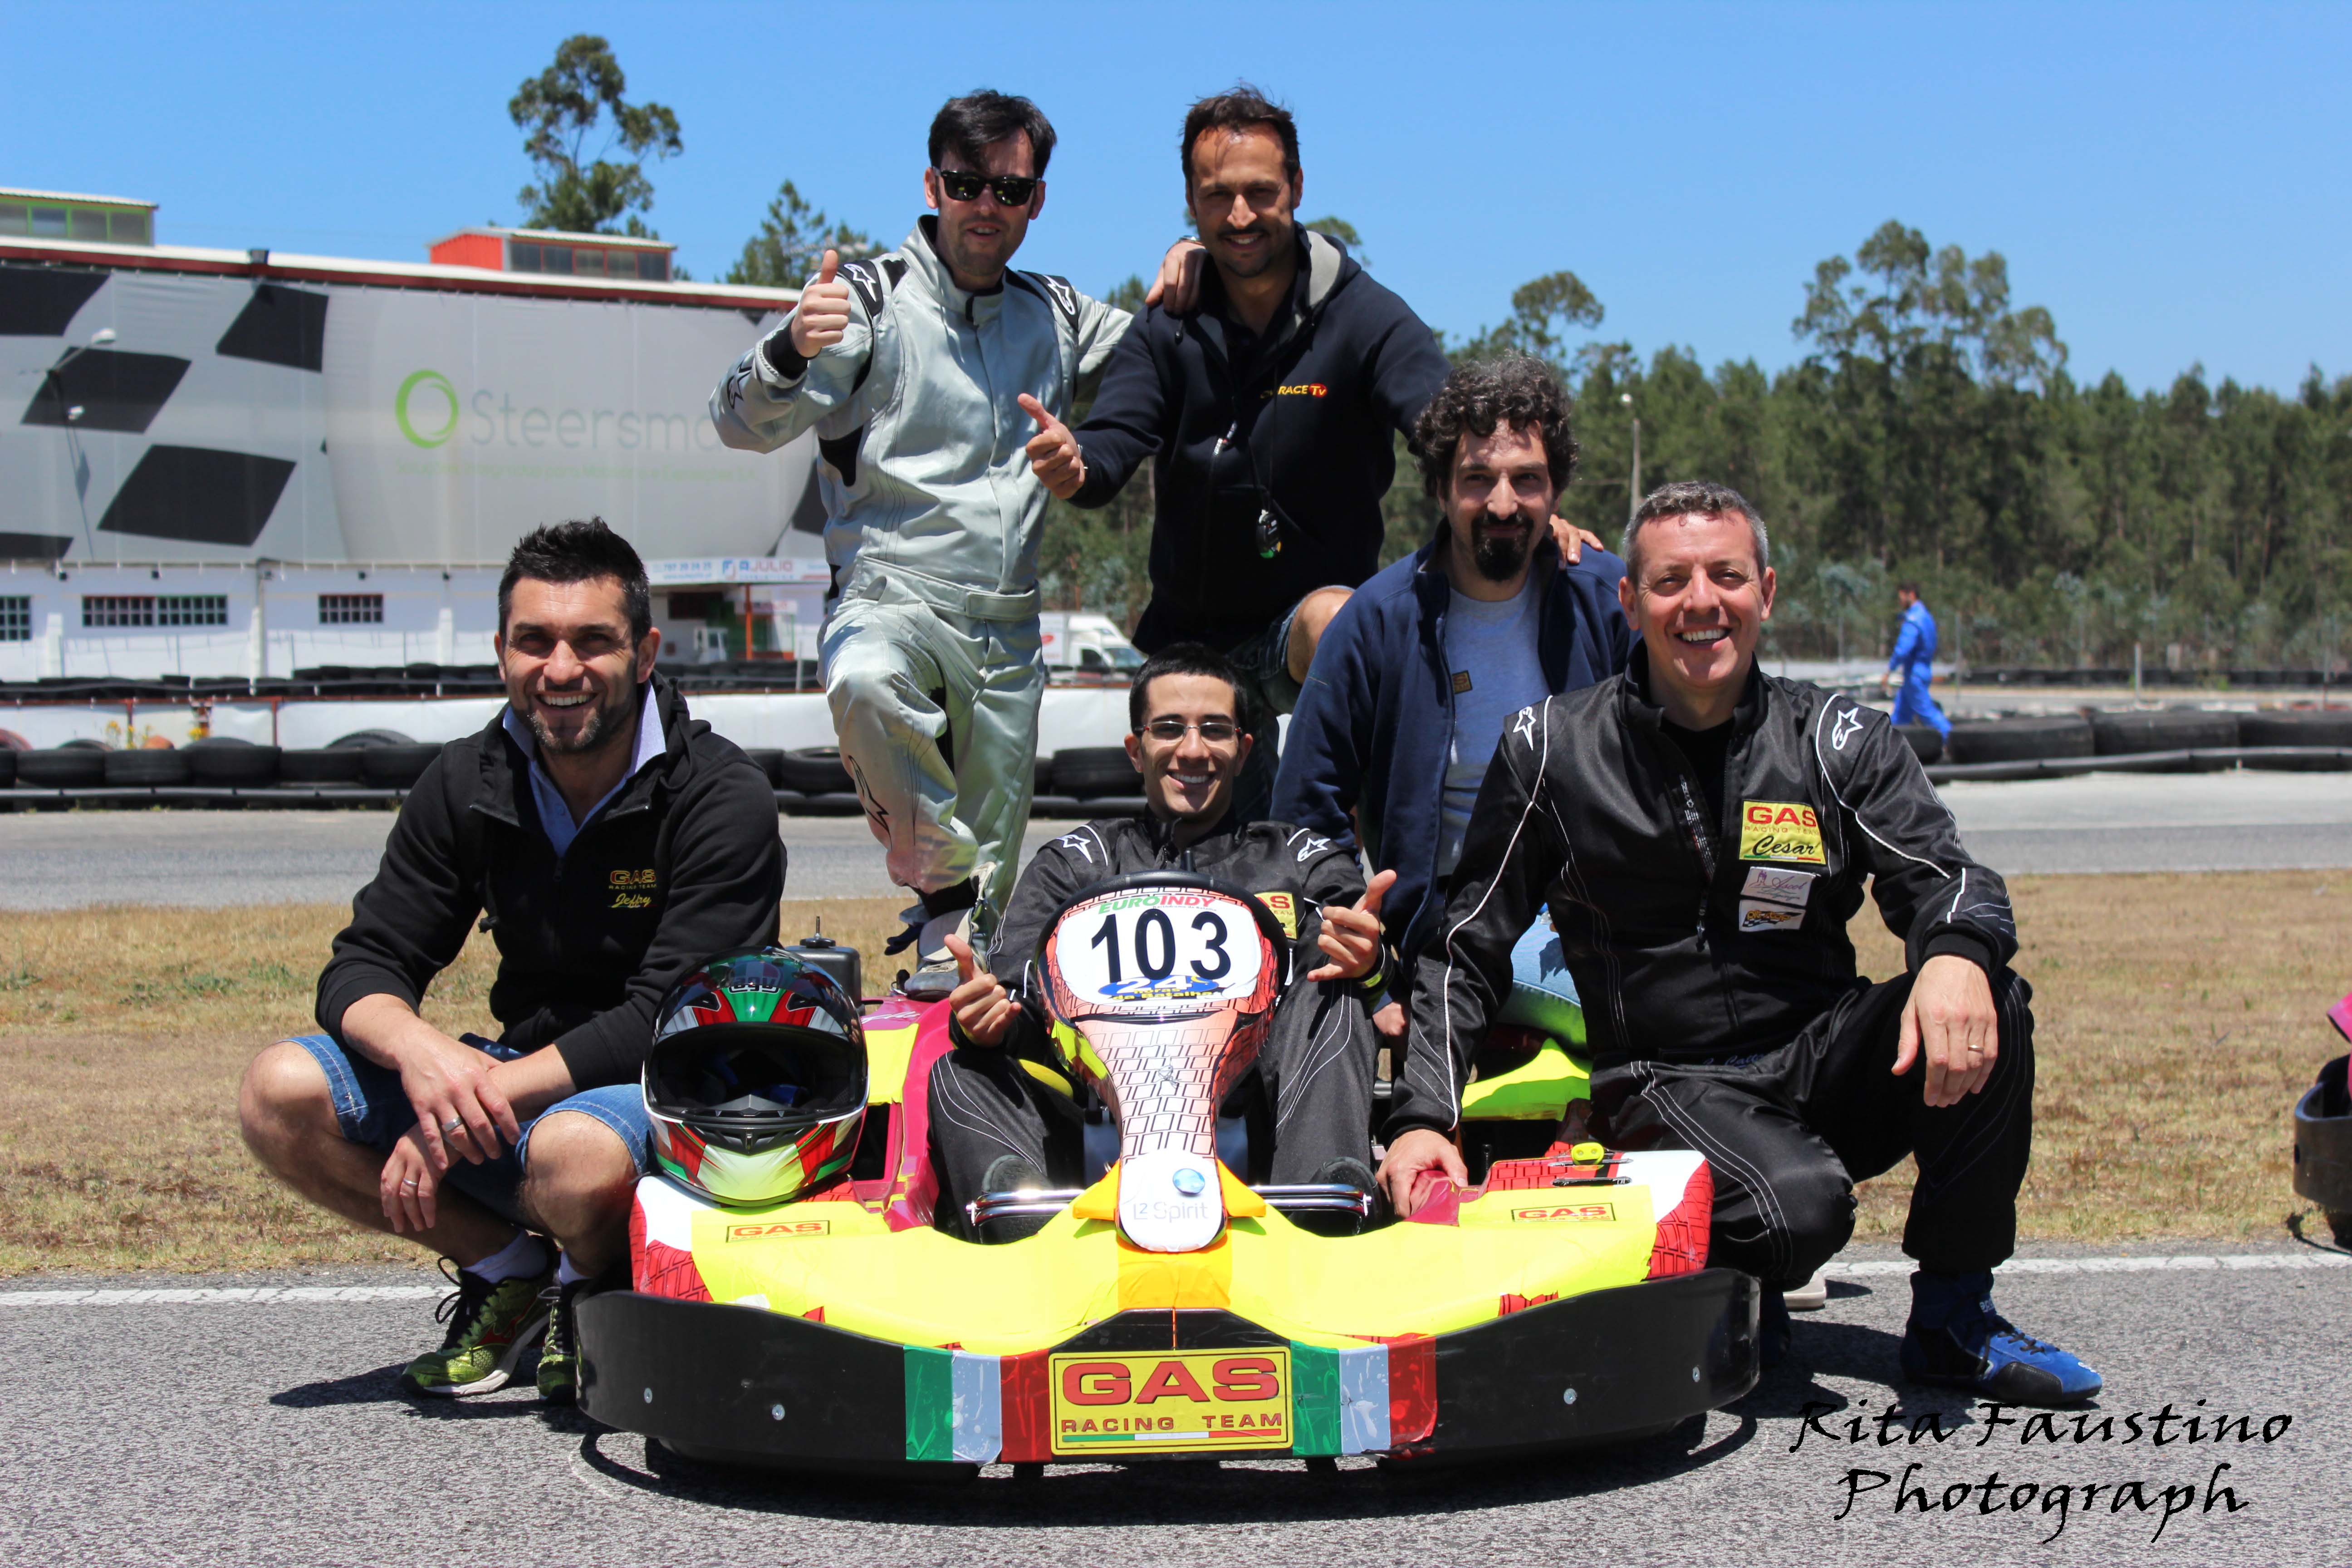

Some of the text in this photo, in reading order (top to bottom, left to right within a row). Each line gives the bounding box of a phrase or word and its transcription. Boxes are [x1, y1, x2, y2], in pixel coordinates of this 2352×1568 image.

[1278, 385, 1308, 395] RACE
[470, 388, 722, 452] Steersma
[1747, 806, 1817, 828] GAS
[1752, 835, 1815, 856] Cesar
[610, 869, 657, 885] GAS
[611, 892, 652, 908] Jeffry
[1098, 895, 1217, 915] EUROINDY
[1091, 908, 1231, 984] 103
[1117, 975, 1192, 994] 24
[1141, 991, 1213, 999] Batalha
[1153, 1201, 1208, 1223] Spirit
[1518, 1206, 1607, 1219] GAS
[734, 1223, 823, 1236] GAS
[1062, 1357, 1280, 1406] GAS
[1061, 1412, 1283, 1433] RACING TEAM
